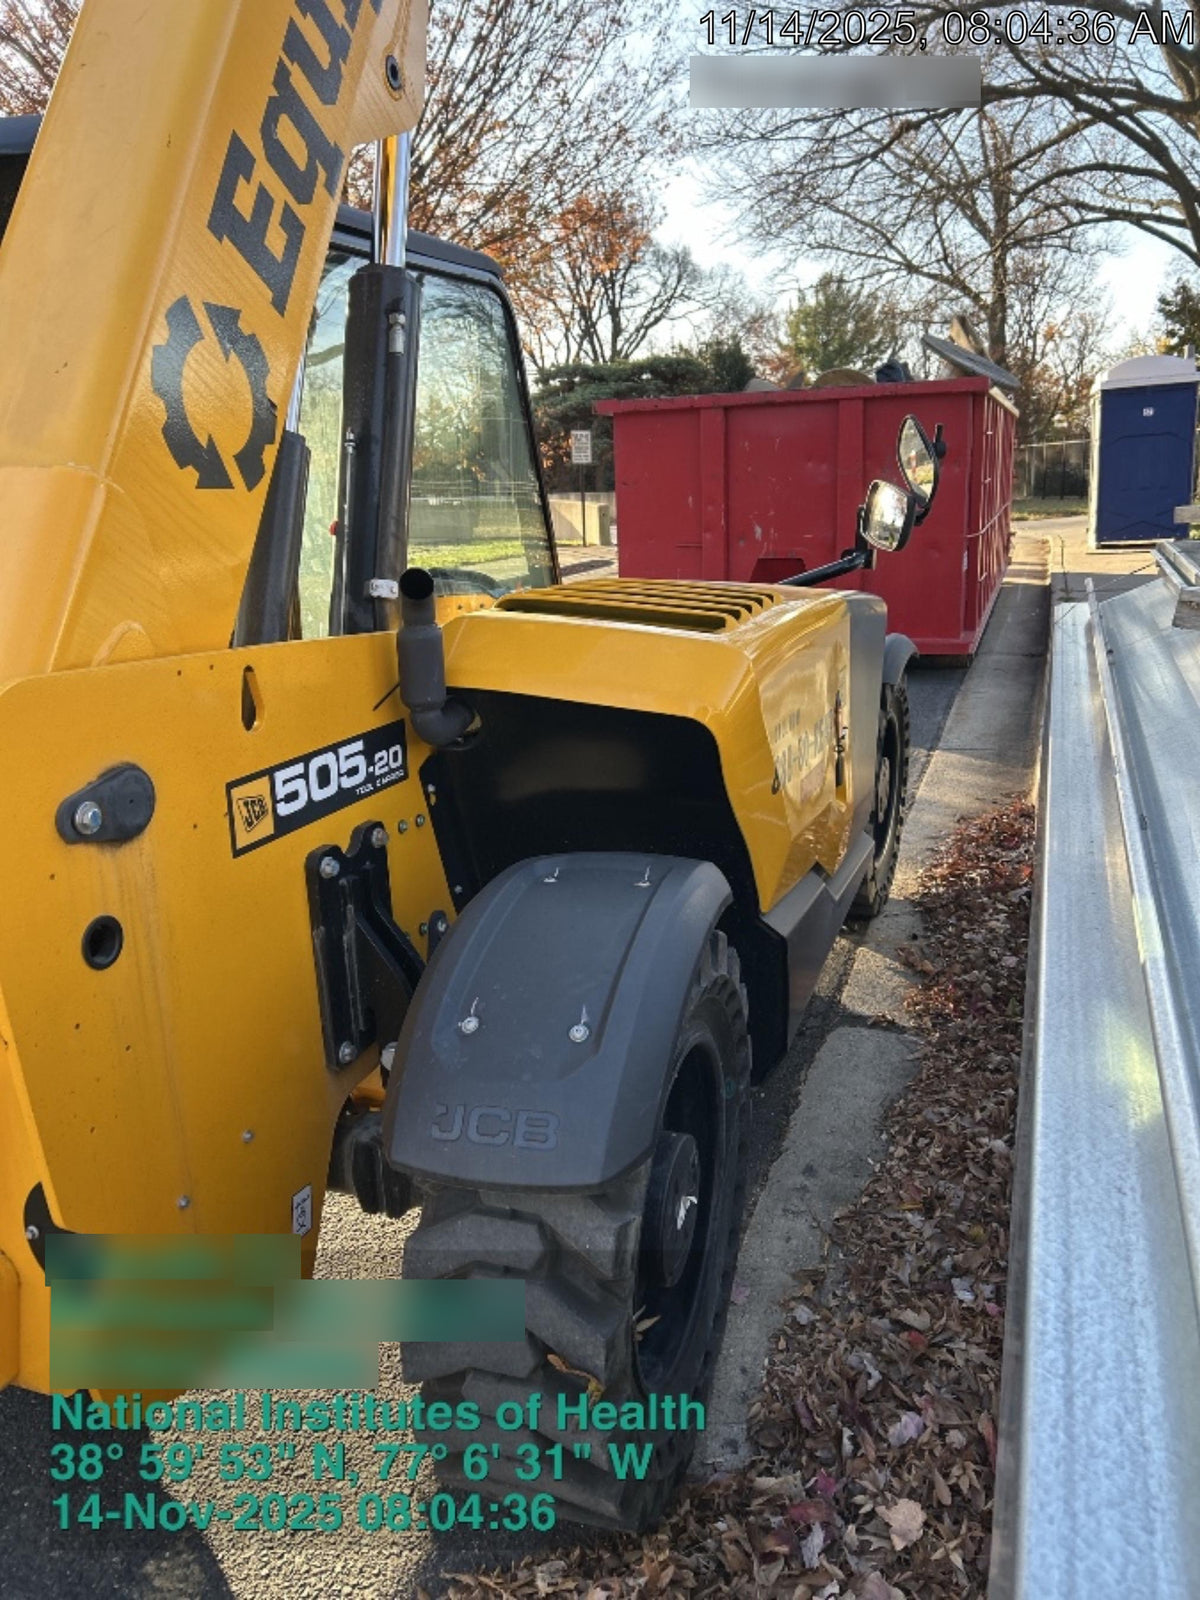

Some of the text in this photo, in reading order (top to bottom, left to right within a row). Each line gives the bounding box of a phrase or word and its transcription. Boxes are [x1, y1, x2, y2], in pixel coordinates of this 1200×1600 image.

[207, 0, 382, 318] Equ
[239, 795, 269, 830] JCB
[430, 1103, 560, 1151] JCB
